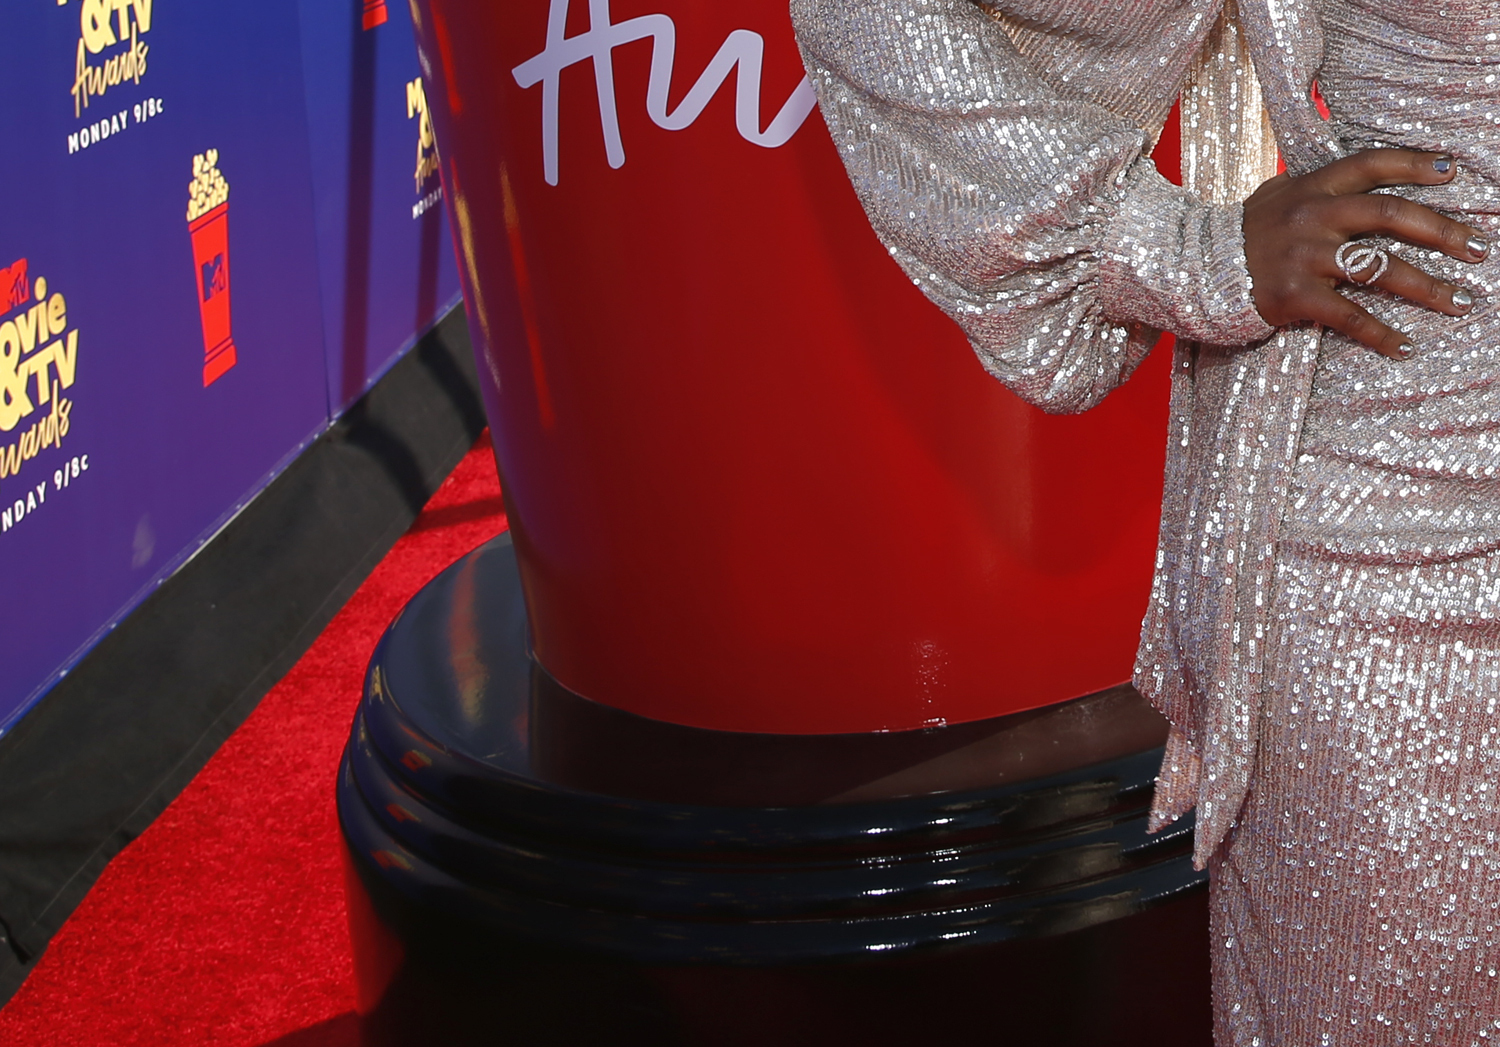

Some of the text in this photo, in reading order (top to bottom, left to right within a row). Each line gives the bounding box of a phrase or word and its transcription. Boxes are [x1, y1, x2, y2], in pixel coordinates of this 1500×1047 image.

[71, 21, 149, 118] Awards
[68, 97, 163, 154] MONDAY 9/8c
[0, 276, 67, 364] ovie
[0, 379, 72, 478] wards
[0, 454, 89, 533] NDAY 9/8c
